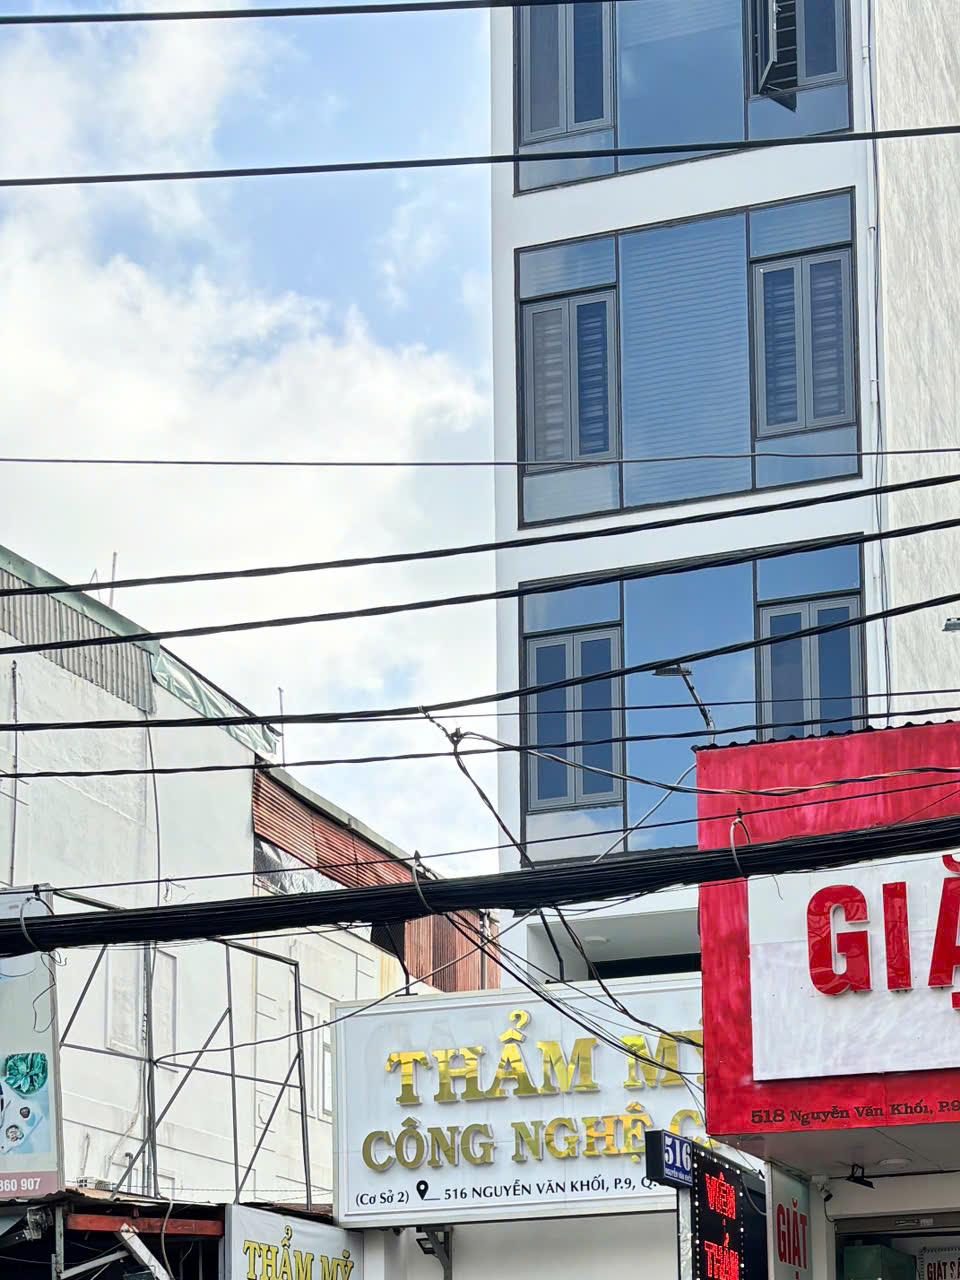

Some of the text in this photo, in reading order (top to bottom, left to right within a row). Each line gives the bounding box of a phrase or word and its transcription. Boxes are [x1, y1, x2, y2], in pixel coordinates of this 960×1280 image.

[385, 1009, 704, 1105] THẨM M
[751, 1109, 785, 1125] 518
[790, 1105, 850, 1126] Nguyễn
[854, 1105, 883, 1118] Văn
[362, 1116, 497, 1173] CÔNG
[511, 1101, 652, 1164] NGHỆ
[665, 1136, 691, 1171] 516
[21, 1178, 40, 1190] 907
[355, 1193, 377, 1207] (Cơ
[379, 1189, 394, 1205] Sở
[397, 1191, 409, 1205] 2)
[444, 1188, 467, 1200] 516
[471, 1178, 532, 1200] NGUYỄN
[536, 1178, 565, 1194] VĂN
[571, 1174, 609, 1193] KHỐI,
[613, 1178, 636, 1193] P.9,
[776, 1198, 808, 1280] GIẶT
